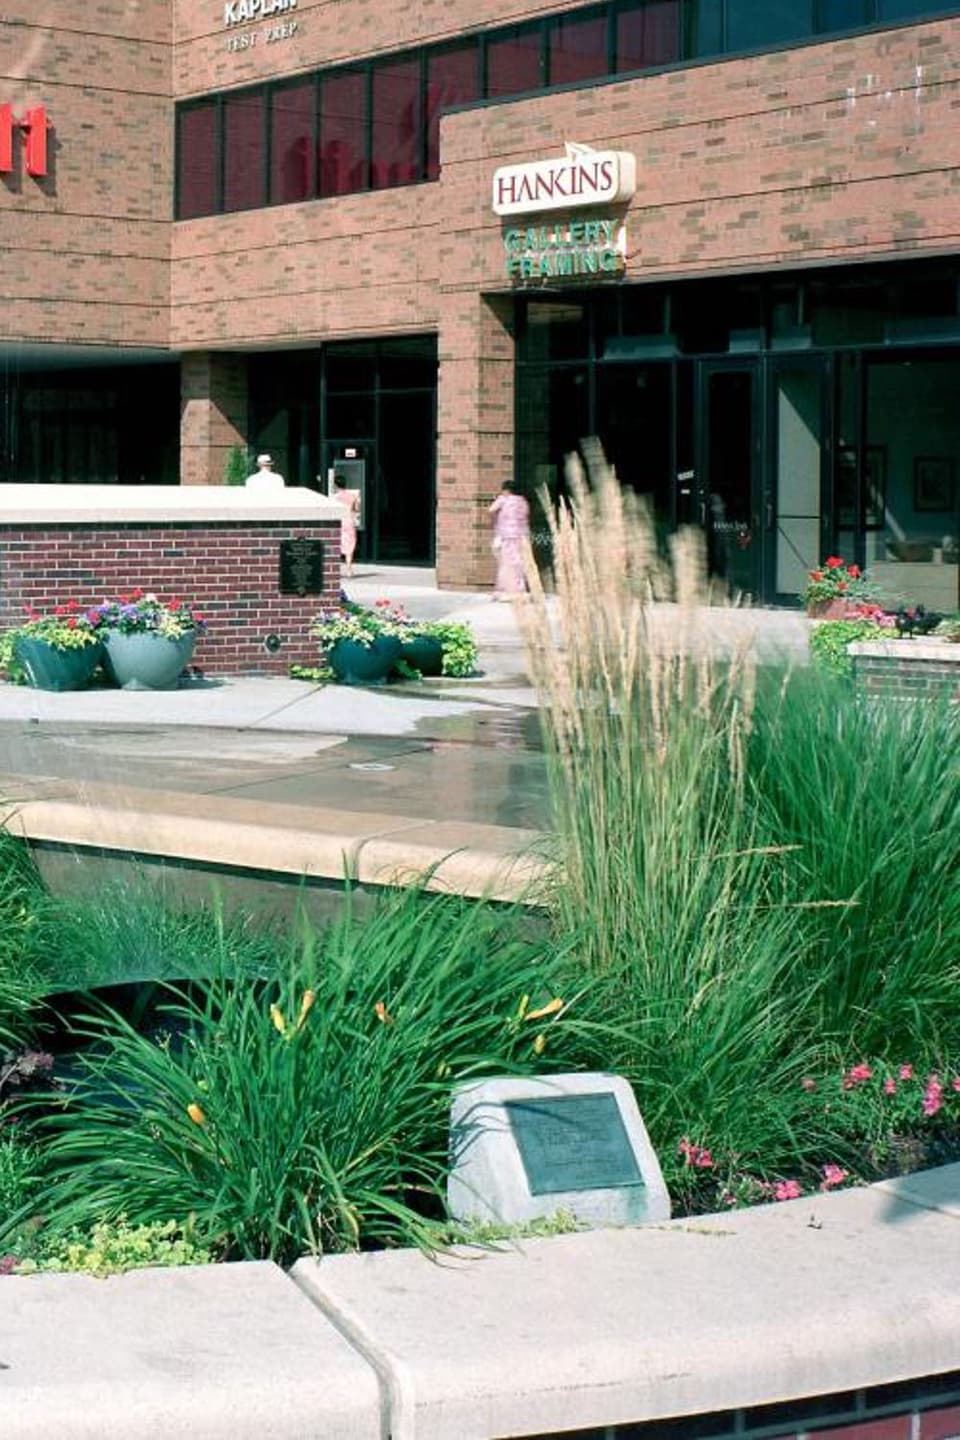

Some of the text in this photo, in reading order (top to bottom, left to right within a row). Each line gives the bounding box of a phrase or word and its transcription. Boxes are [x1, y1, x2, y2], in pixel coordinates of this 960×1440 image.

[227, 21, 297, 52] TEST PREP
[497, 161, 613, 204] HANKINS
[505, 219, 618, 251] GALLERY
[506, 247, 617, 280] FRAMING
